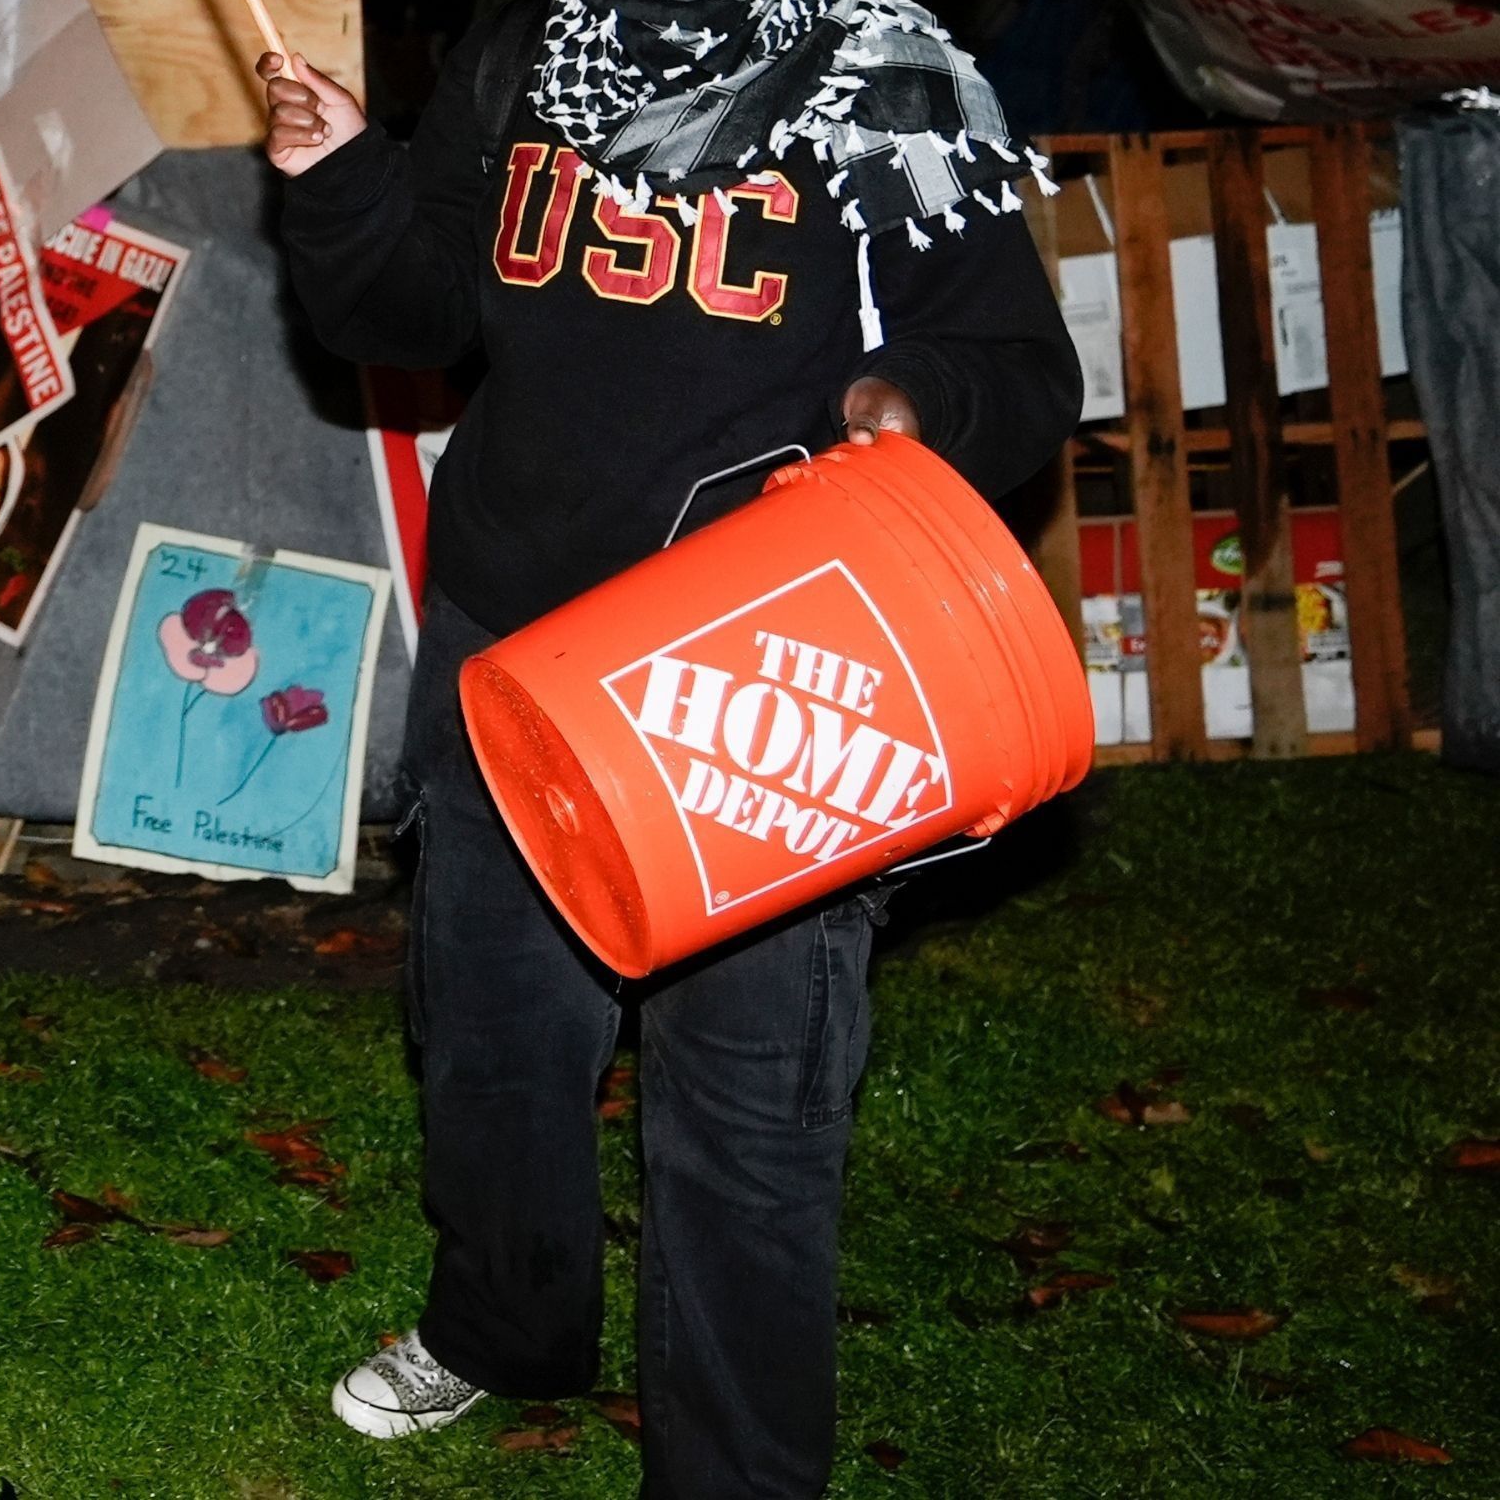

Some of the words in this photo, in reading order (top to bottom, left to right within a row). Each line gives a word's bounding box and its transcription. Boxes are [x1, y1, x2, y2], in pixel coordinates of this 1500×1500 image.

[493, 142, 800, 323] USC
[160, 548, 210, 582] 24
[754, 629, 884, 719] THE
[637, 653, 945, 830] HOME
[133, 793, 171, 834] Free
[194, 809, 285, 853] Palestine
[680, 756, 861, 862] DEPOT
